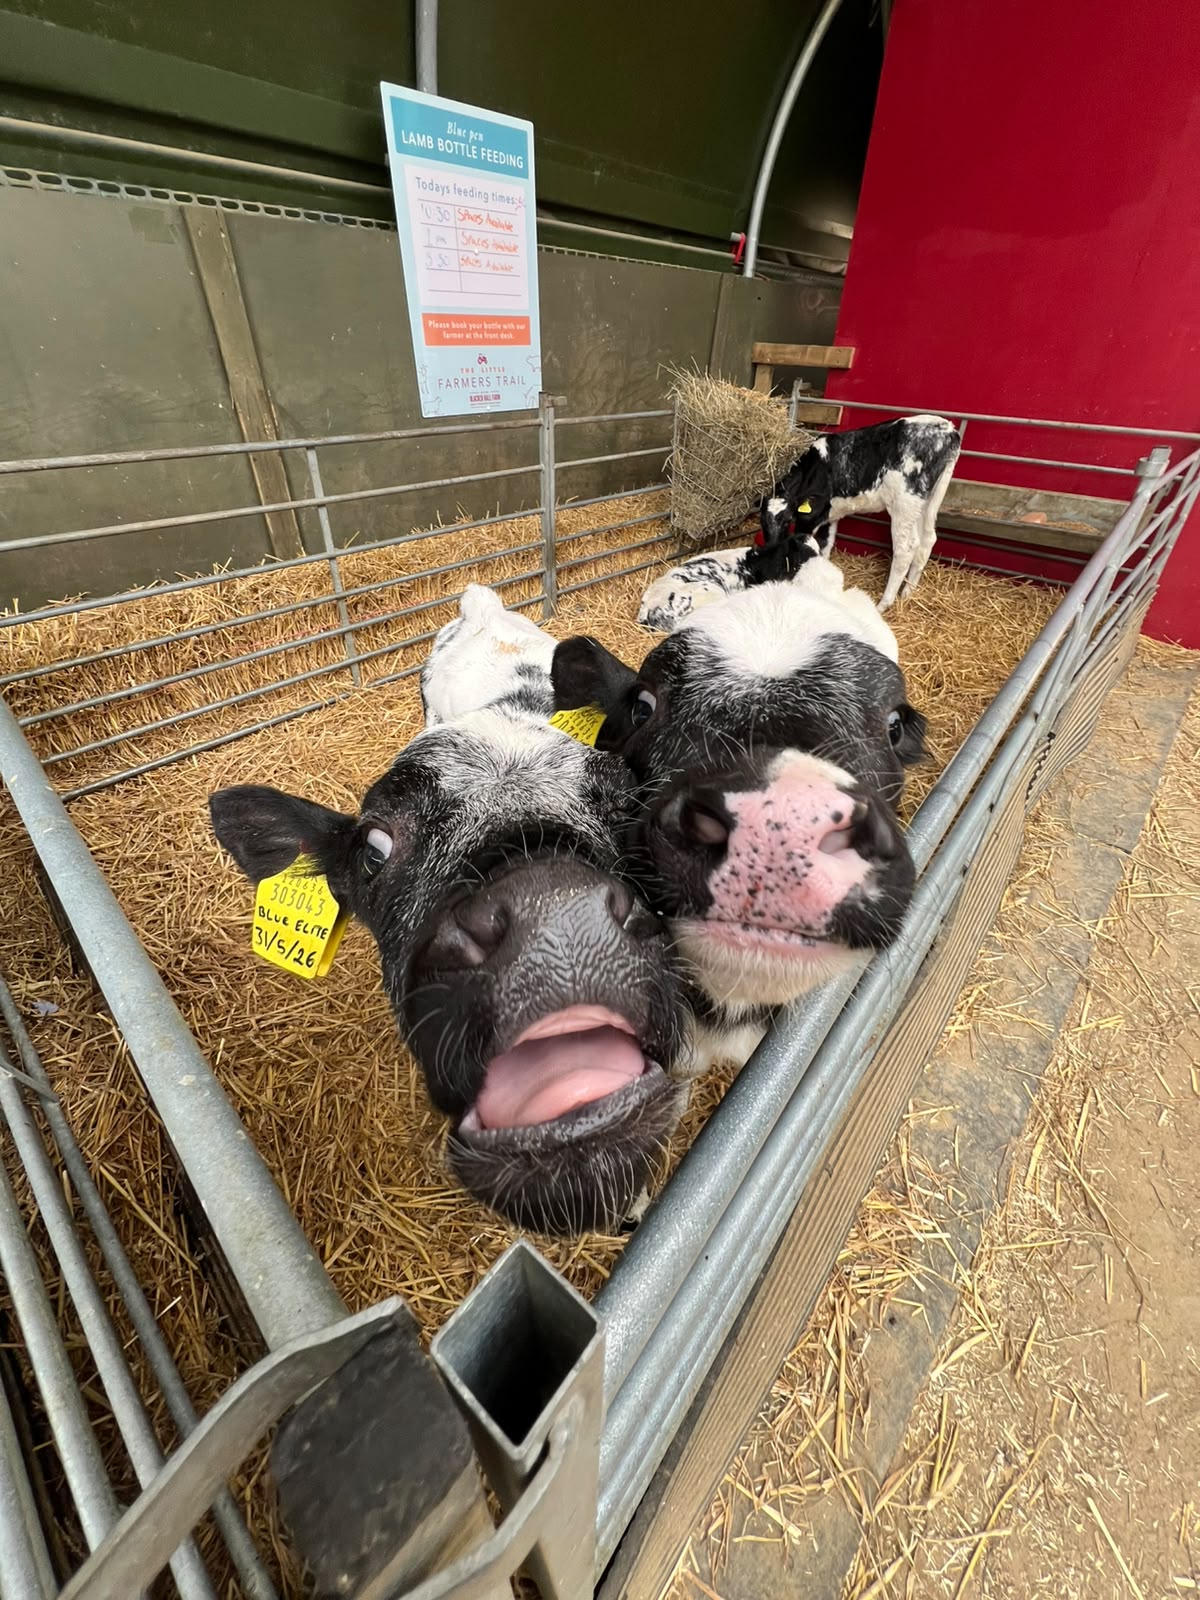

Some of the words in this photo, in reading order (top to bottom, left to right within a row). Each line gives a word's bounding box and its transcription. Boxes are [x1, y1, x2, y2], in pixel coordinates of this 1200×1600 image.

[446, 121, 466, 138] Blue
[469, 130, 484, 143] pen
[401, 129, 434, 149] LAMB
[437, 138, 478, 159] BOTTLE
[481, 147, 524, 169] FEEDING
[416, 176, 450, 196] Todays
[453, 183, 489, 203] feeding
[428, 320, 450, 329] Please
[451, 320, 468, 329] book
[469, 322, 482, 331] your
[483, 322, 502, 330] bottle
[502, 323, 515, 331] with
[443, 331, 463, 339] farmer
[473, 331, 484, 339] the
[484, 331, 500, 339] front
[480, 366, 506, 374] LITTLE
[438, 376, 492, 390] FARMERS
[496, 375, 527, 386] TRAIL
[270, 883, 326, 917] 303043
[258, 905, 290, 926] BLUE
[255, 926, 317, 969] 31/5/26
